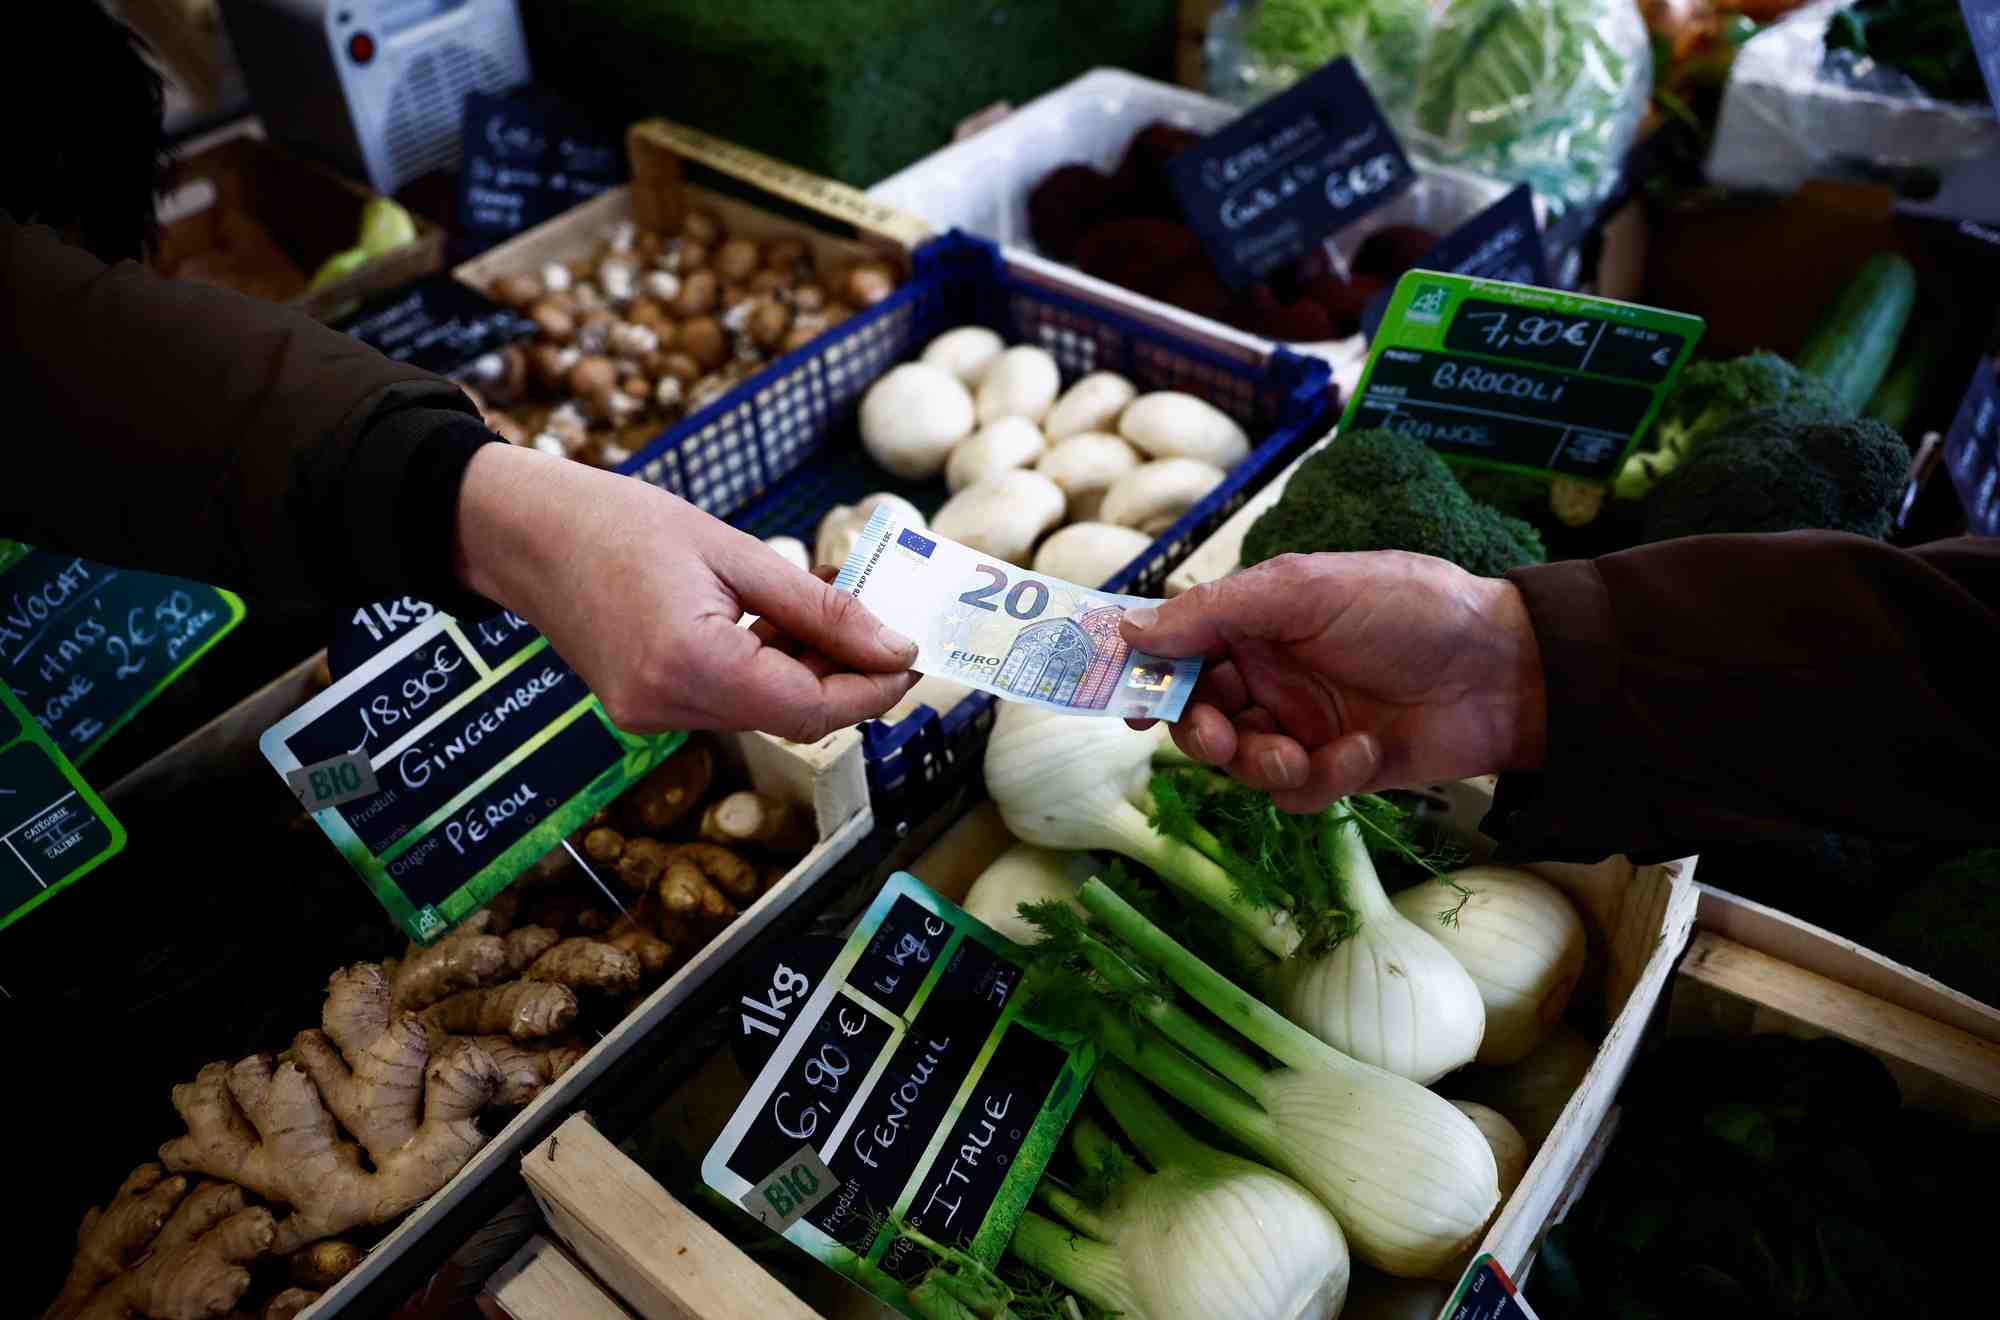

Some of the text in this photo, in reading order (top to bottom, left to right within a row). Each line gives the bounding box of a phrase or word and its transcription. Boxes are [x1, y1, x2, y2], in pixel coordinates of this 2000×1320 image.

[1466, 311, 1590, 349] 7,90€
[958, 563, 1050, 621] 20
[949, 650, 1001, 667] EURO
[310, 762, 361, 801] BIO
[350, 789, 400, 829] Produit
[391, 839, 441, 876] Origine
[740, 963, 810, 1037] 1kg
[763, 1163, 819, 1217] BIO
[823, 1176, 862, 1232] Produit
